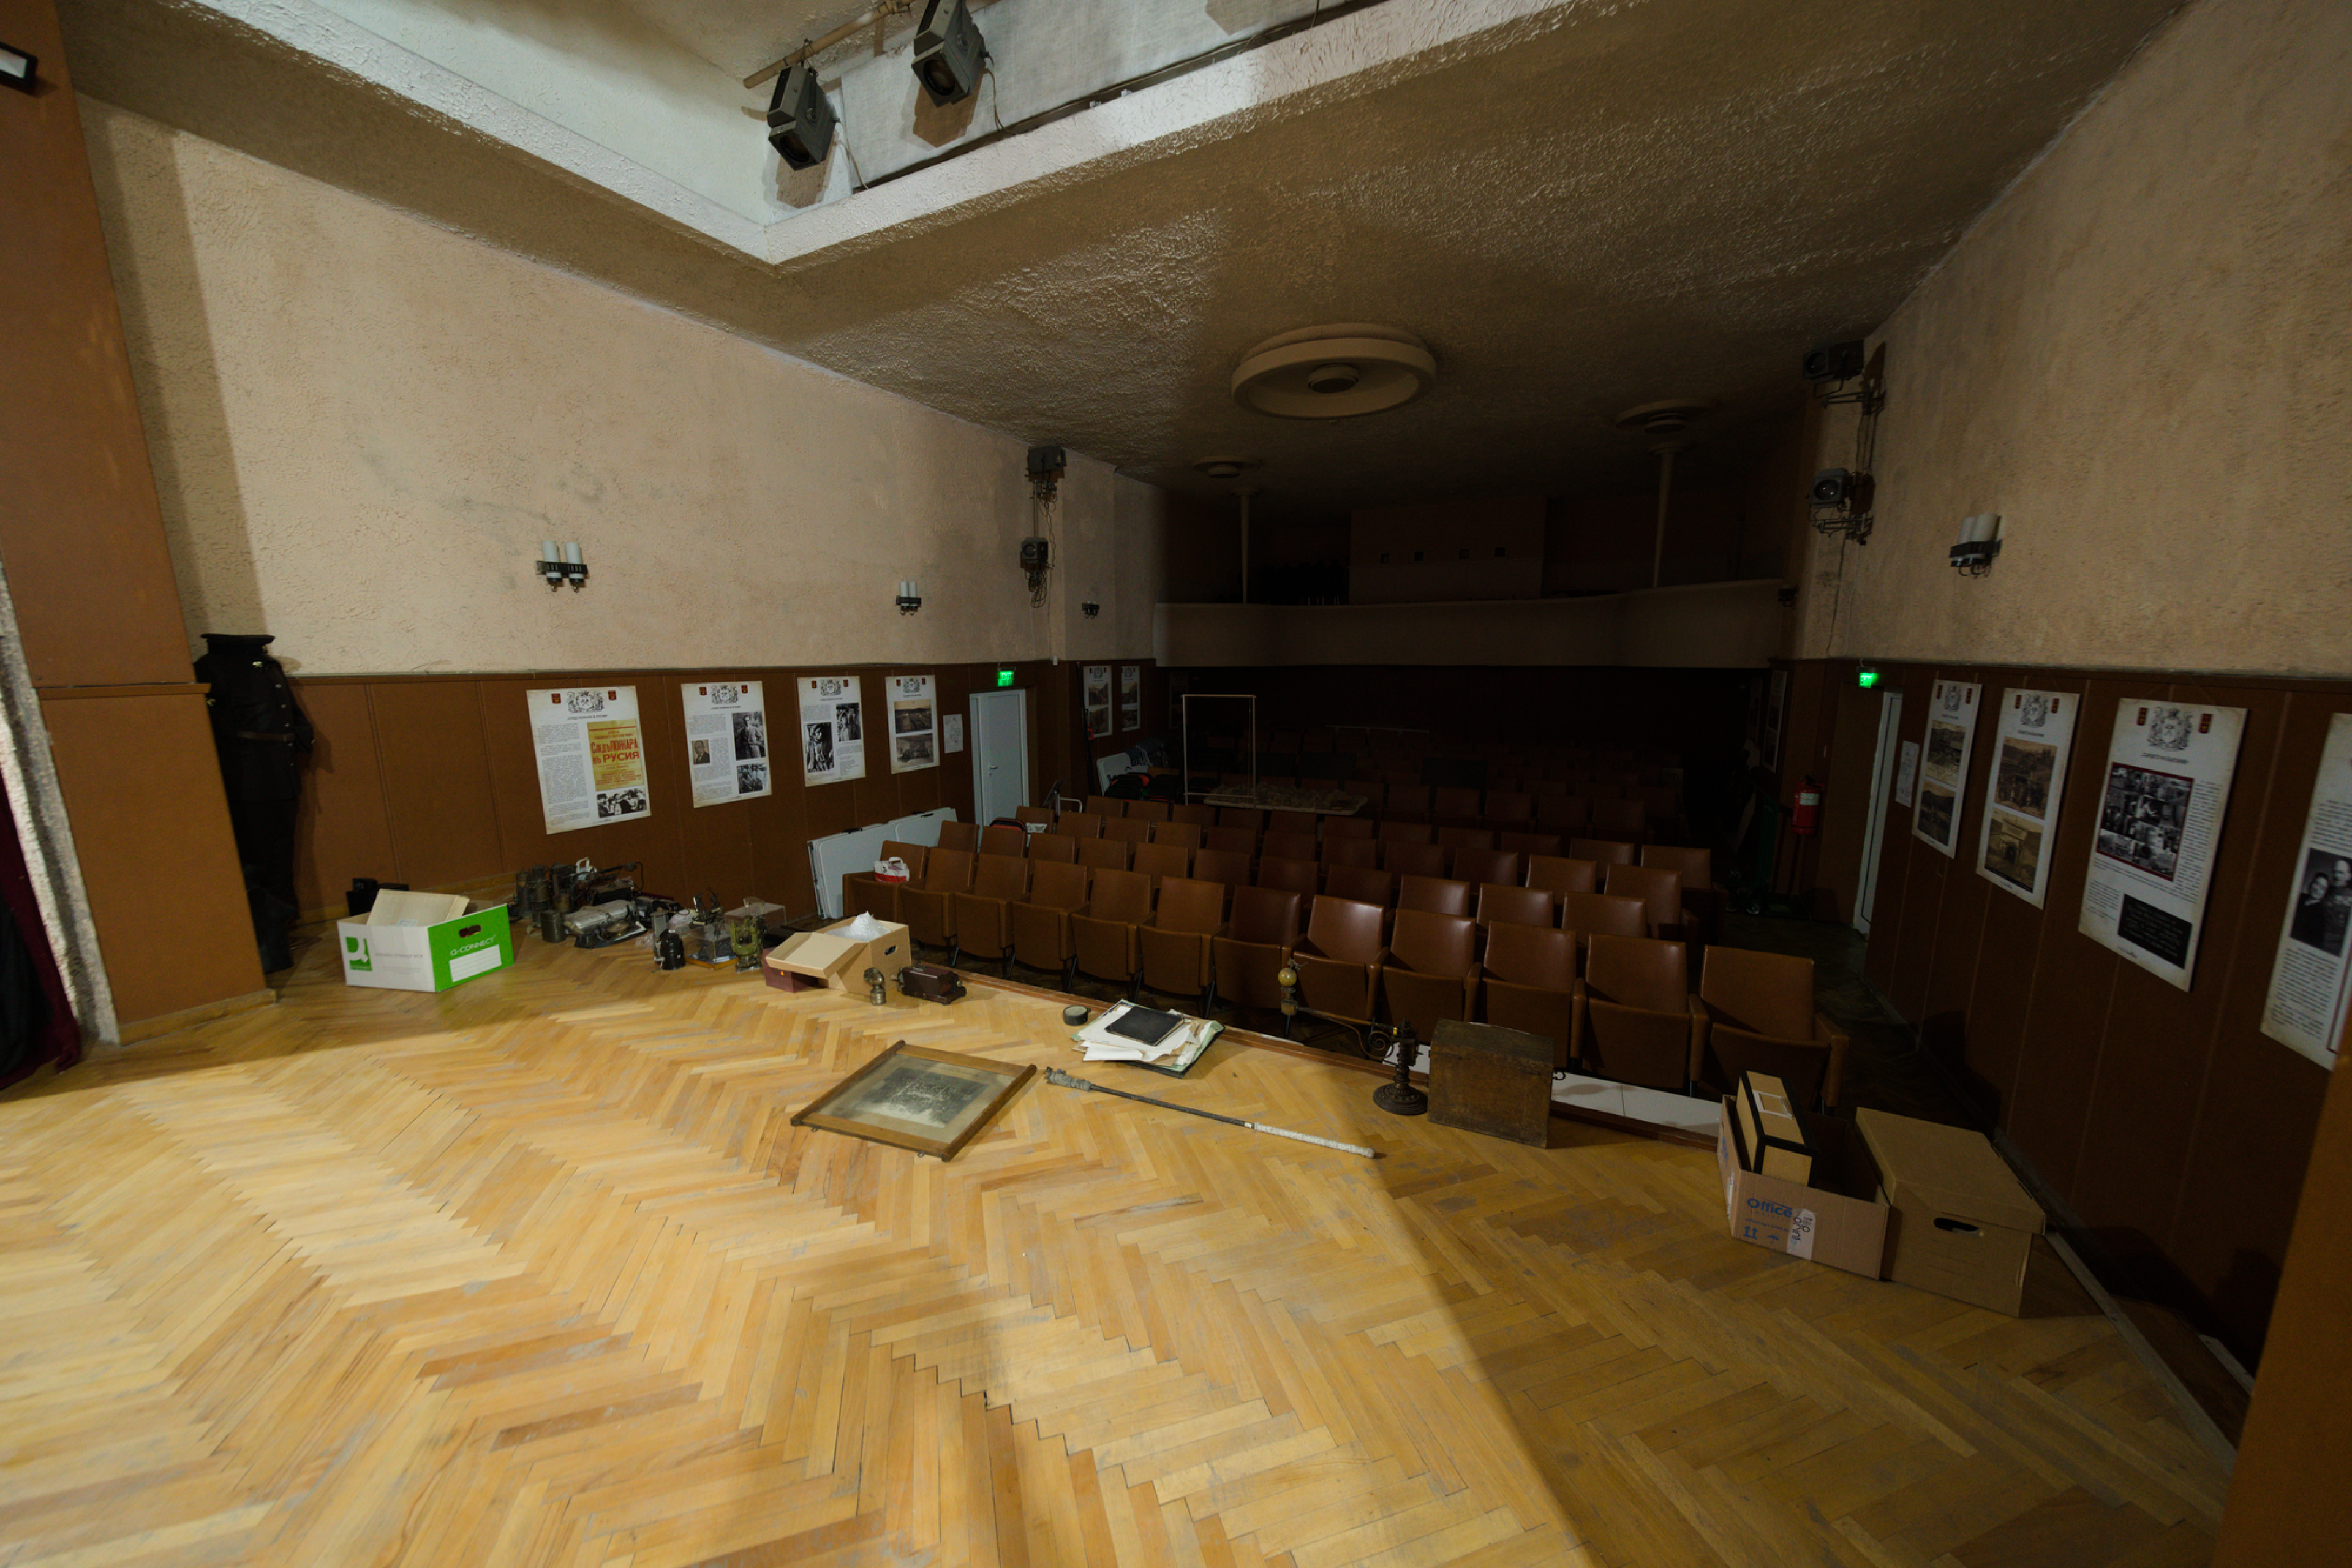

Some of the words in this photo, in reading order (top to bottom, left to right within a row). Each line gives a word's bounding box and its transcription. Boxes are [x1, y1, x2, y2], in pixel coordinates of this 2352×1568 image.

[610, 738, 638, 751] ПОЖАРА
[603, 751, 639, 763] РУСИЯ
[1747, 1198, 1793, 1218] Office
